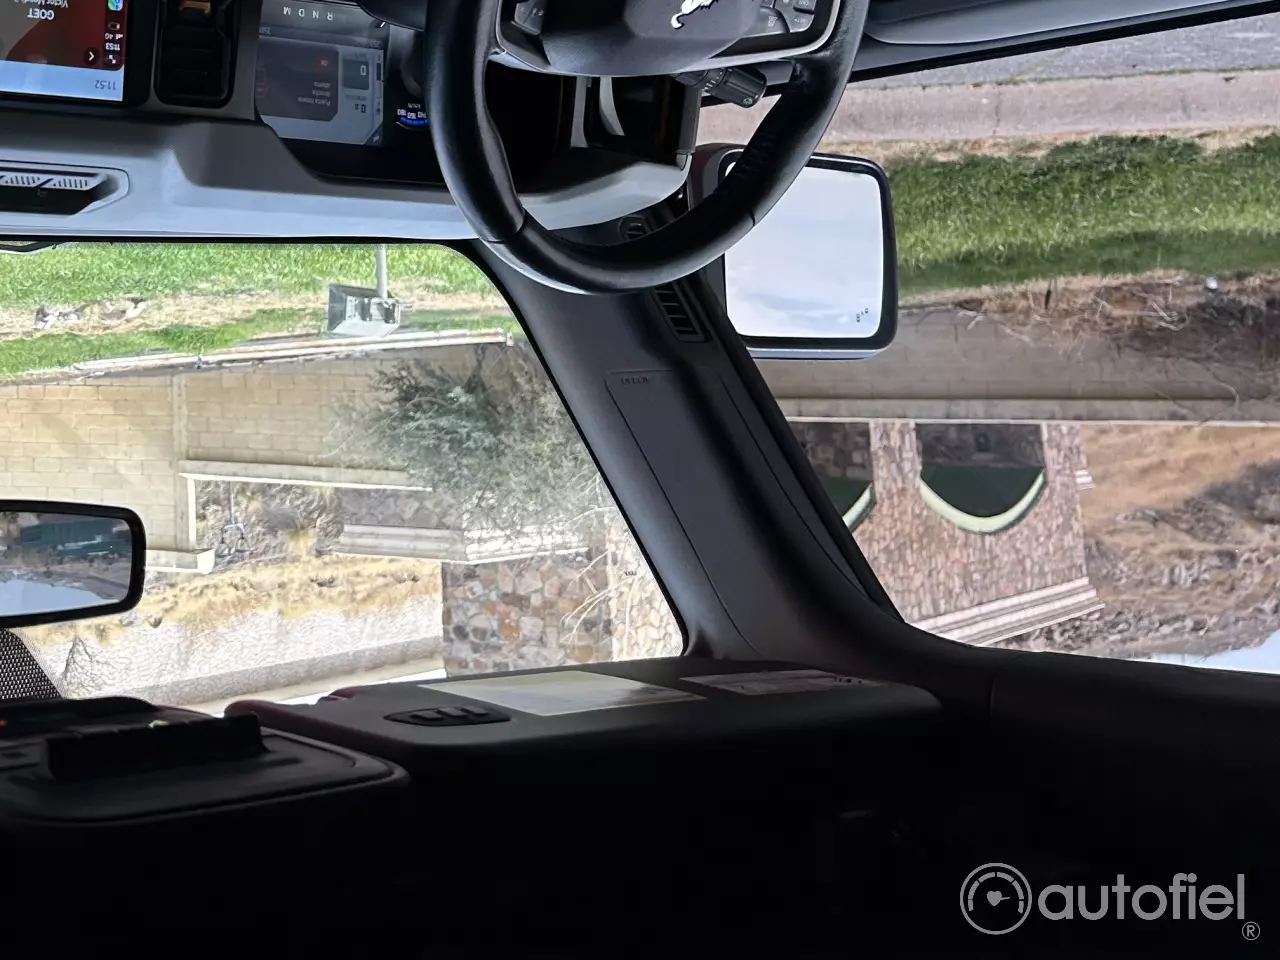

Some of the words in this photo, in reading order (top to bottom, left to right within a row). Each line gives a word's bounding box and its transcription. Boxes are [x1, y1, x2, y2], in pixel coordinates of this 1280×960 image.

[27, 8, 54, 20] GOET
[104, 32, 113, 40] 4G
[106, 42, 120, 50] 11:53
[94, 79, 117, 91] 11:52
